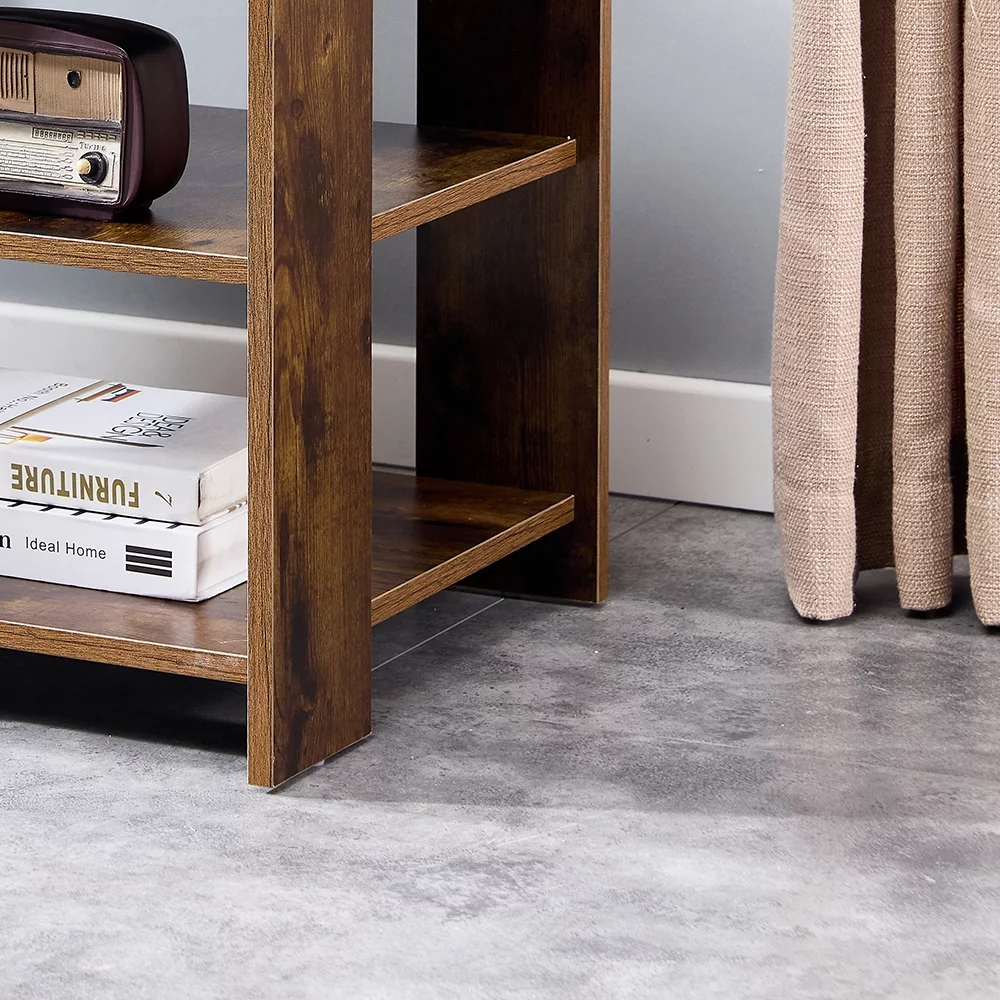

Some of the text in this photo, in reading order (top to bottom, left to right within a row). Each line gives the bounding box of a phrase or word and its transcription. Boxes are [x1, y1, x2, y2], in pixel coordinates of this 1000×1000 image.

[10, 462, 139, 508] FURNITURE
[25, 536, 60, 553] Ideal
[65, 543, 107, 560] Home
